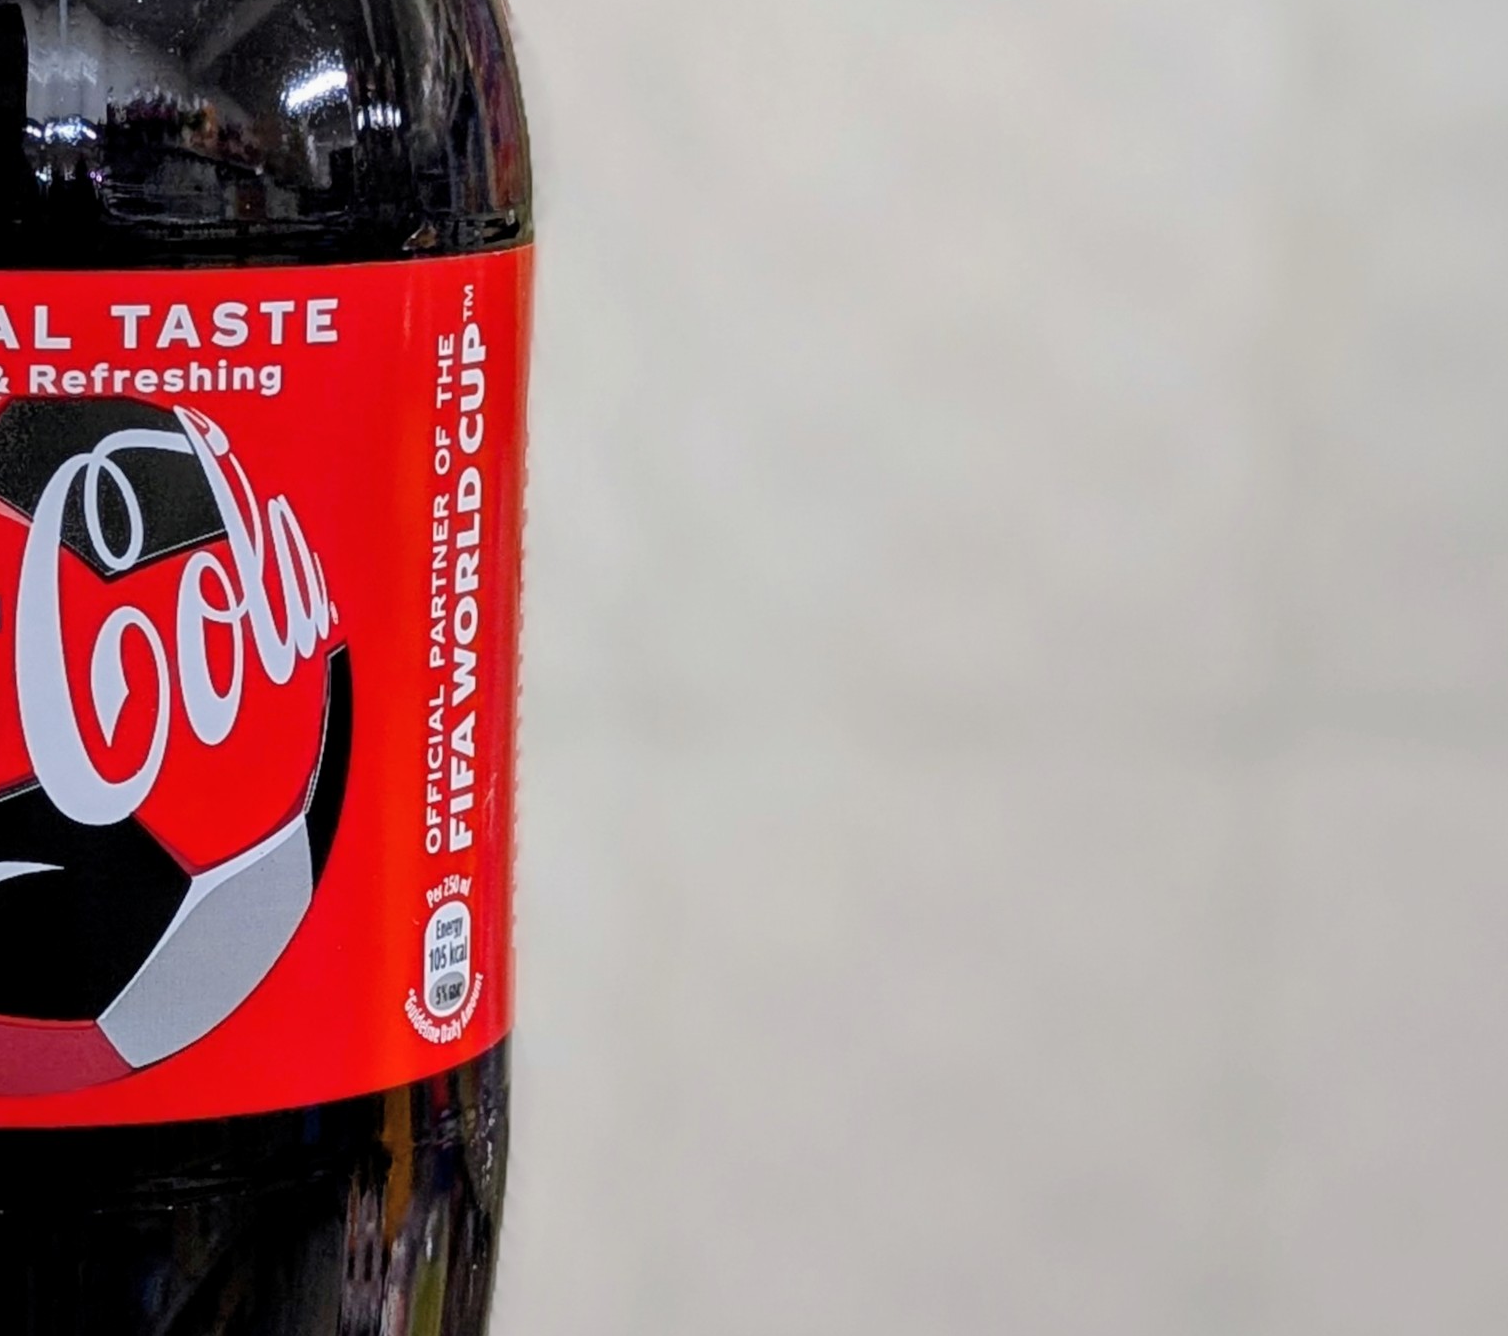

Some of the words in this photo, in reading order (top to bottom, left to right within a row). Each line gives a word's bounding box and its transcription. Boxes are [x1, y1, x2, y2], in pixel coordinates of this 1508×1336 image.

[110, 298, 339, 349] TASTE
[28, 358, 282, 396] Refreshing
[436, 333, 455, 409] THE
[434, 425, 452, 476] OF
[429, 492, 450, 668] PARTNER
[451, 466, 483, 708] WORLD
[425, 683, 445, 854] OFFICIAL
[448, 710, 476, 853] FIFA
[425, 884, 443, 909] Per
[443, 873, 460, 897] 250
[435, 916, 464, 940] Energy
[429, 944, 448, 973] 105
[449, 935, 468, 967] kcal
